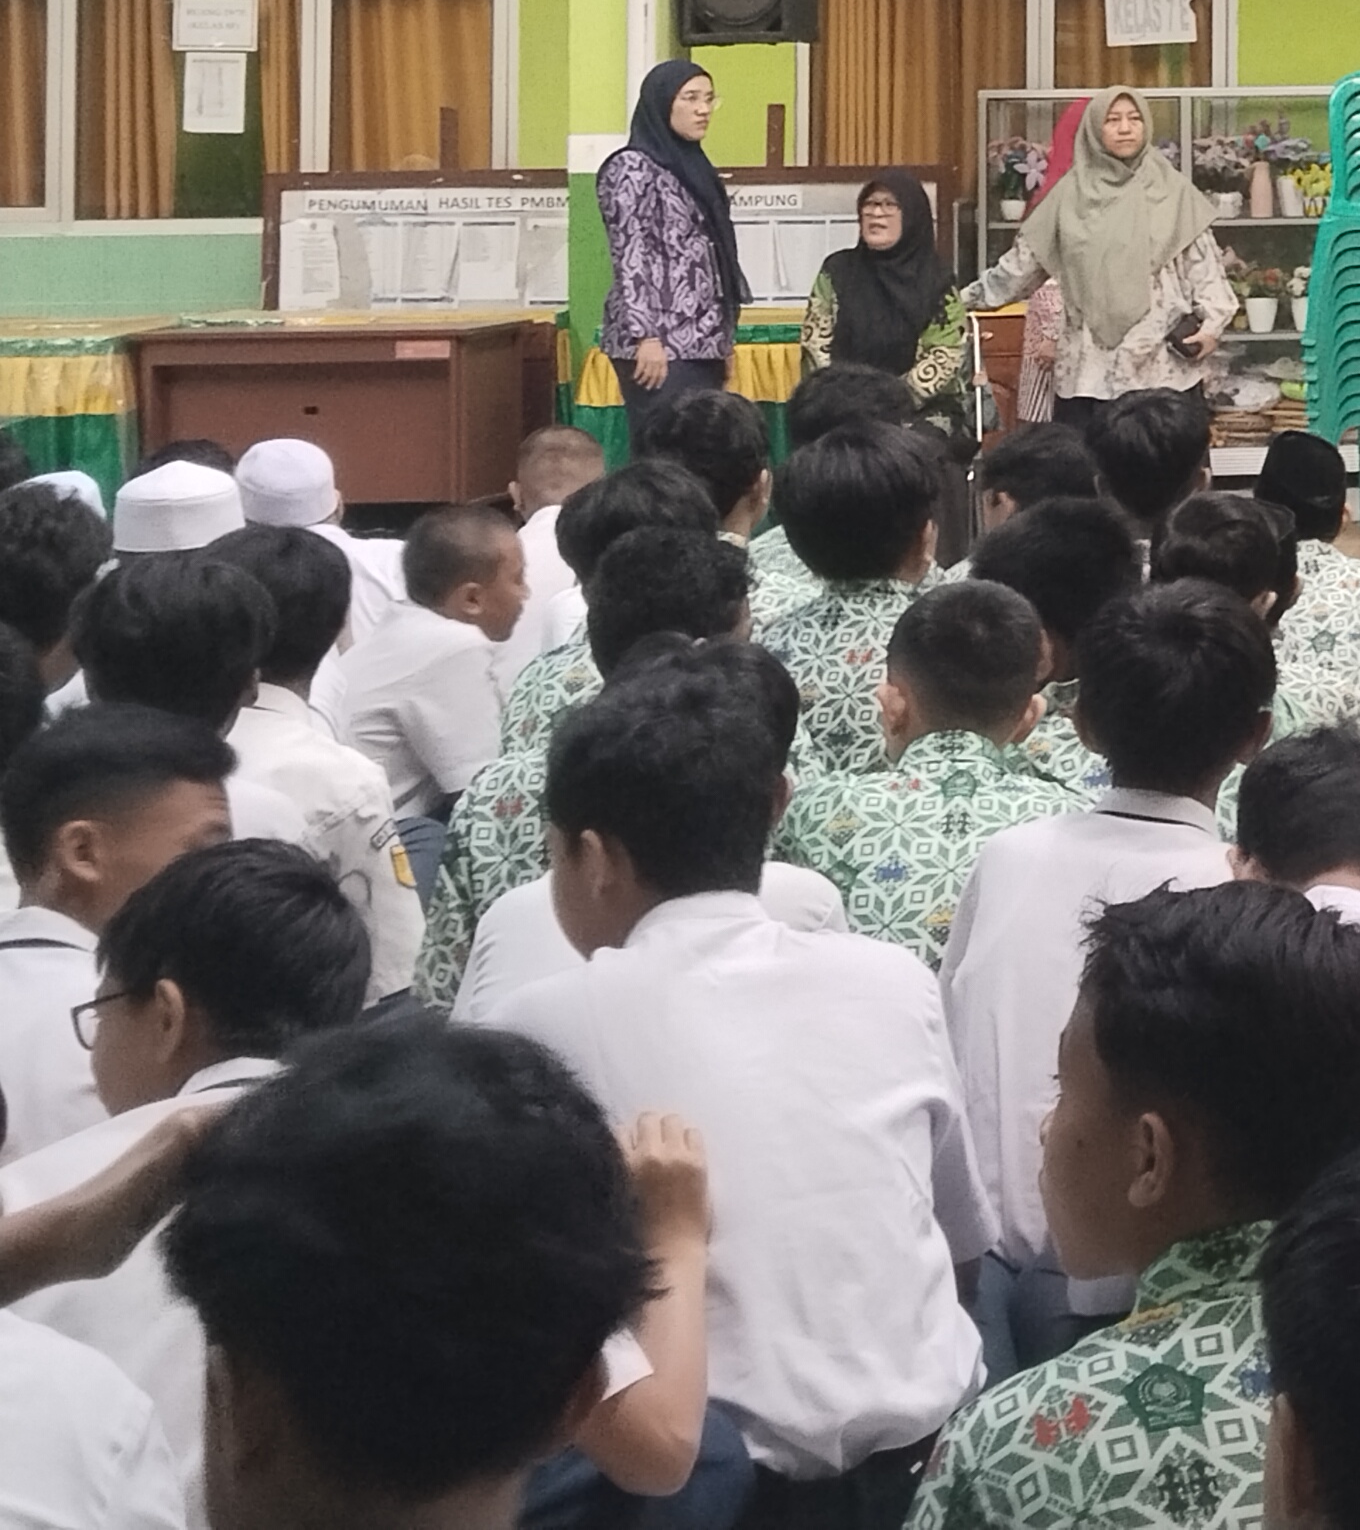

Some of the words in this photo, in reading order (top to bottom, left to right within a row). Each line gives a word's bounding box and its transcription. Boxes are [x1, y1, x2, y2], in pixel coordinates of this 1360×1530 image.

[308, 199, 429, 212] PENGUMUMAN
[439, 197, 481, 210] HASIL
[486, 197, 513, 209] TES
[728, 193, 798, 207] AMPUNG
